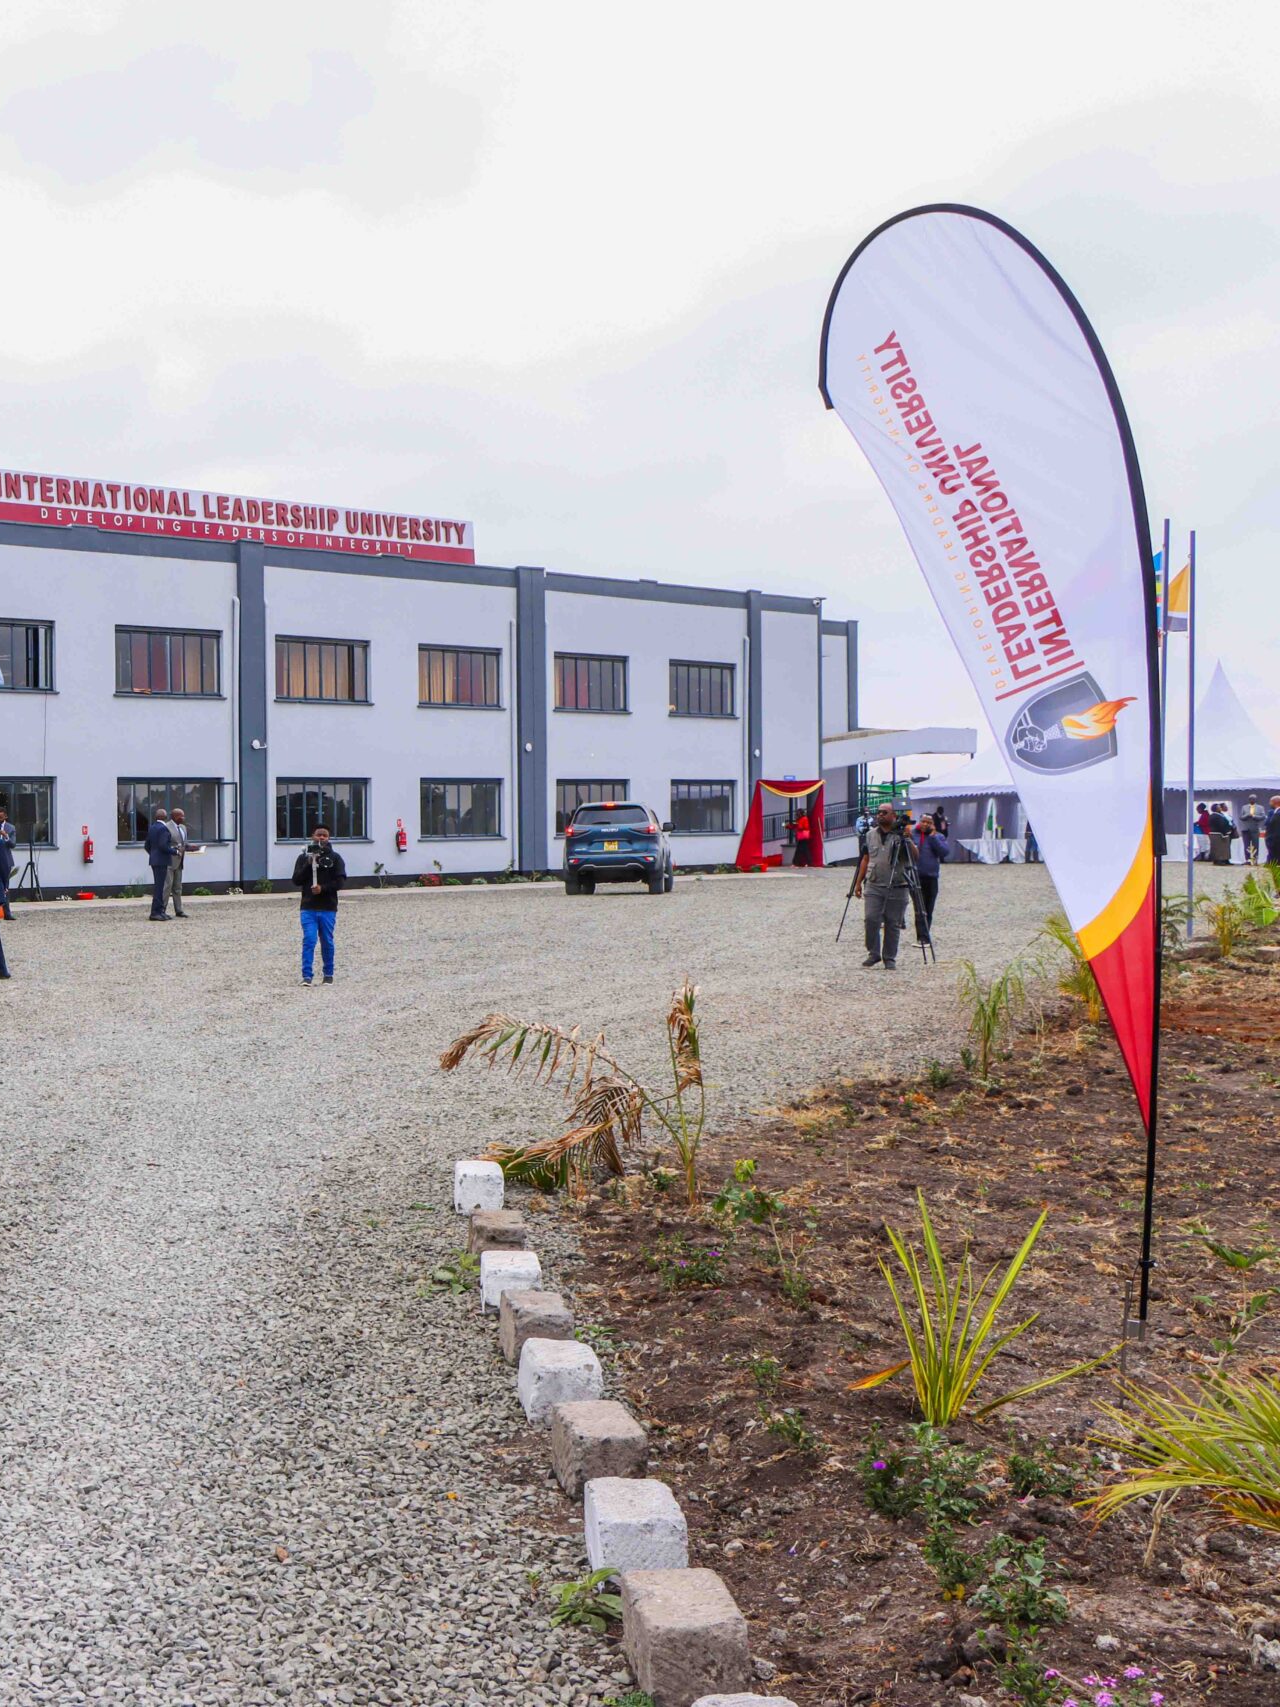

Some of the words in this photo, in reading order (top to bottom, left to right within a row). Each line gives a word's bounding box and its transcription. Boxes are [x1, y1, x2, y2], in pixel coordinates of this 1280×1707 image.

[40, 507, 182, 533] DEVELOPING
[191, 524, 279, 543] LEADERS
[286, 533, 305, 545] OF
[315, 537, 414, 555] INTEGRITY
[202, 494, 340, 532] LEADERSHIP
[345, 510, 467, 545] UNIVERSITY
